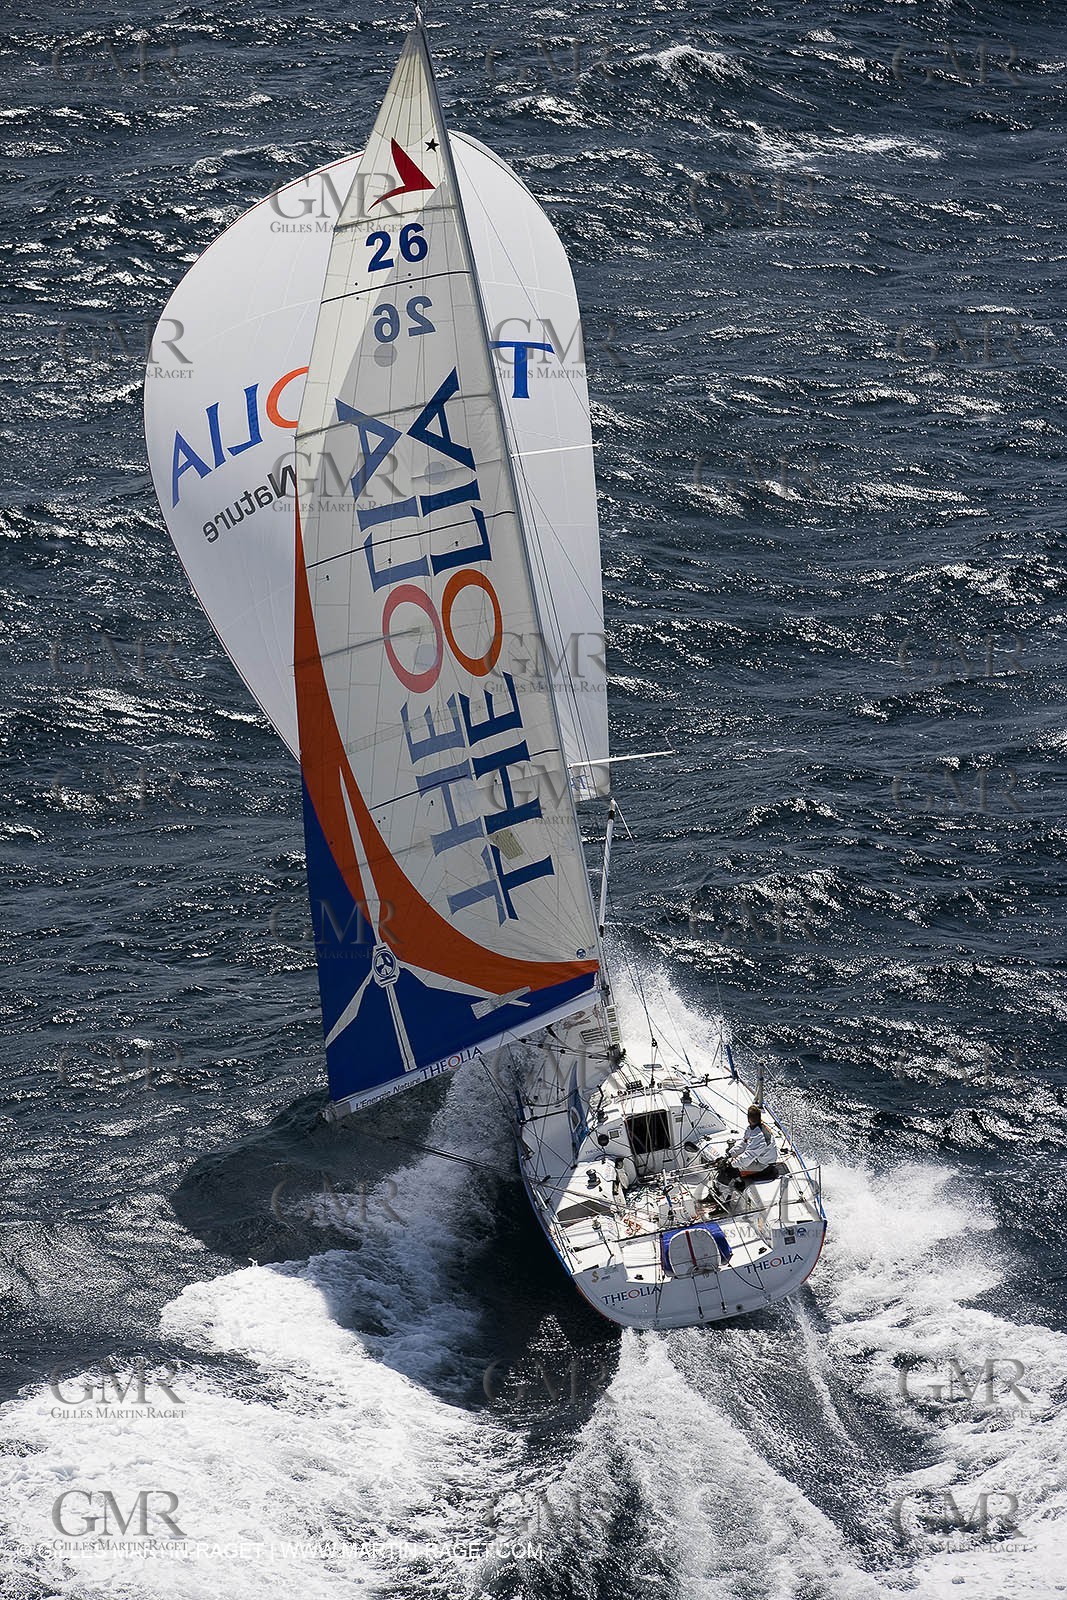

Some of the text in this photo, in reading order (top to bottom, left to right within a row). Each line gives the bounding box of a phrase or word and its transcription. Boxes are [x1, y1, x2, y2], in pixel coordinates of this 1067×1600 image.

[365, 222, 429, 273] 26
[407, 366, 556, 921] THEOLIA
[420, 1046, 483, 1080] THEOLIA
[744, 1252, 805, 1275] THEOLIA
[601, 1285, 663, 1306] THEOLIA
